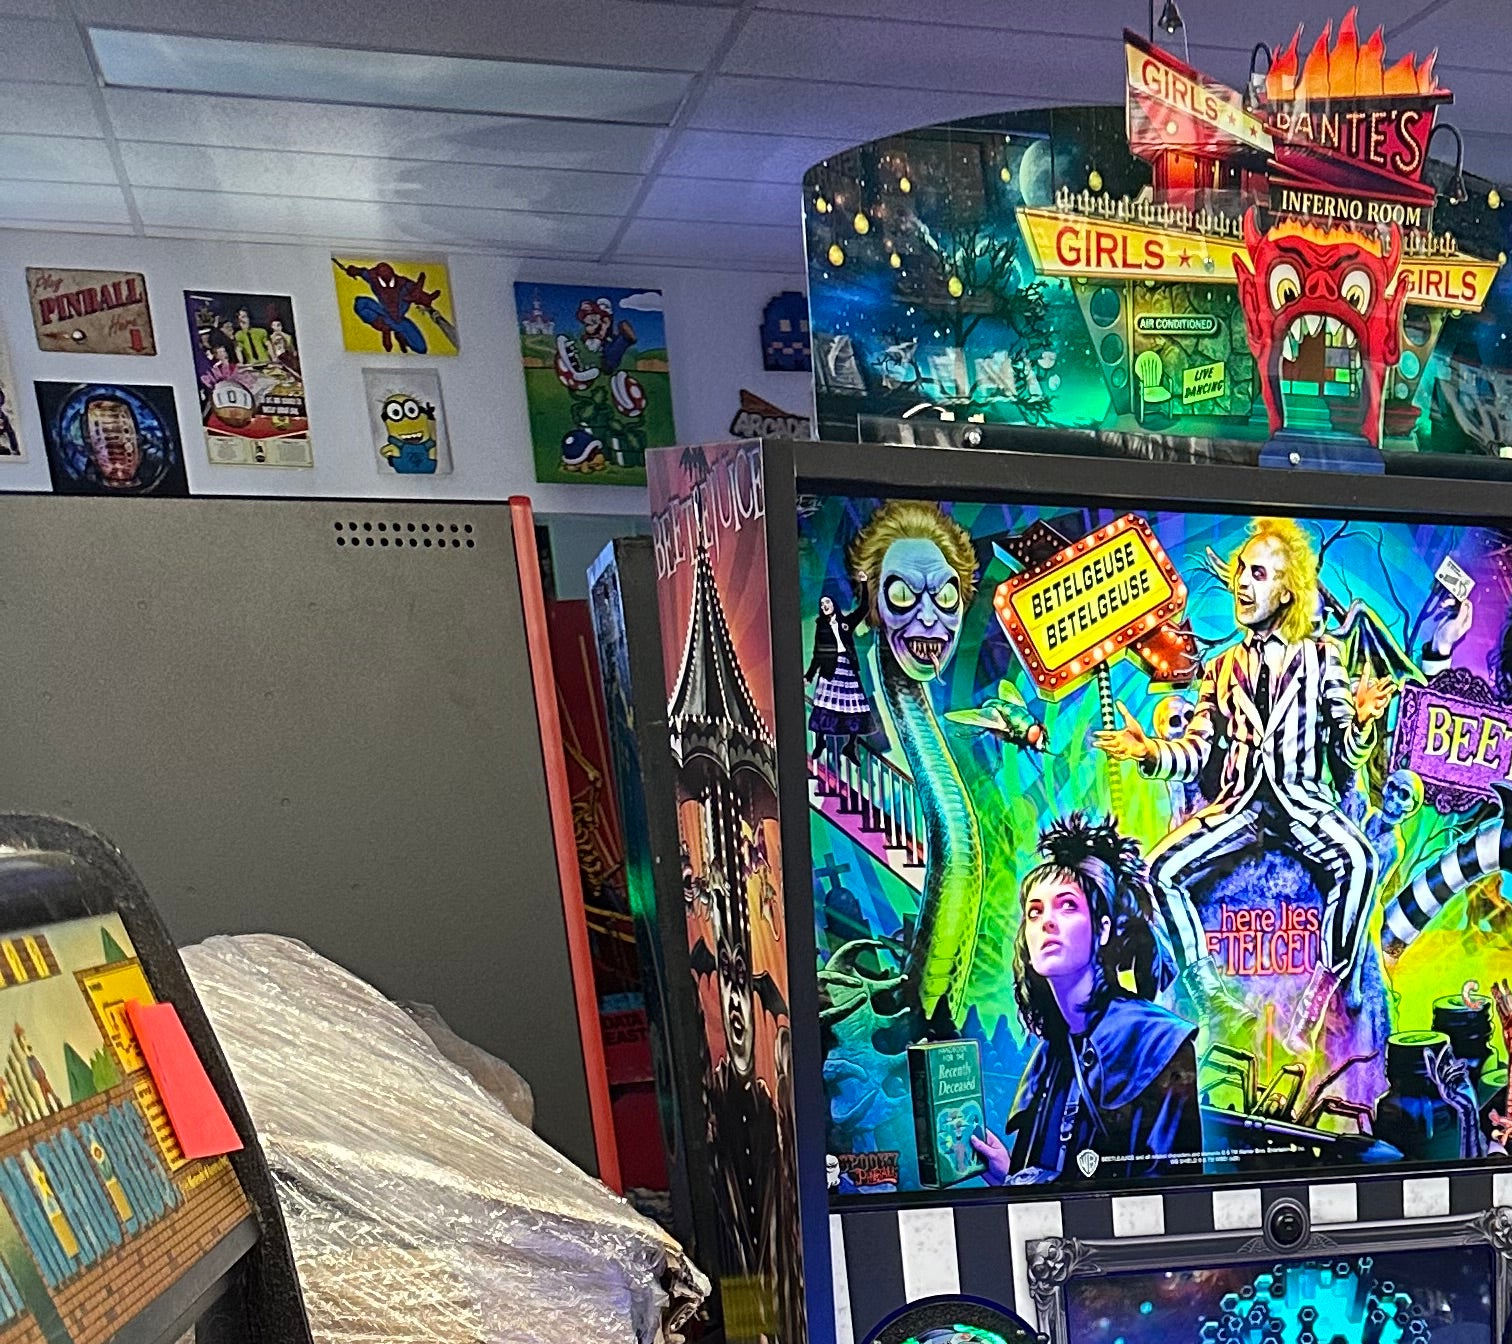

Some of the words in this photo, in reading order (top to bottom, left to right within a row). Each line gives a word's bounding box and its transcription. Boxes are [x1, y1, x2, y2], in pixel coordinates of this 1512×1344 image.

[1141, 58, 1219, 121] GIRLS
[1276, 109, 1423, 175] DANTE'S
[1281, 189, 1364, 221] INFERNO
[1367, 201, 1423, 227] ROOM
[1056, 225, 1166, 270] GIRLS
[39, 278, 143, 325] PINBALL
[1402, 270, 1478, 302] GIRLS
[1155, 318, 1214, 331] CONDITIONED
[1194, 366, 1215, 381] LIVE
[732, 411, 811, 438] ARCADE
[1031, 541, 1135, 620] BETELGEUSE
[1046, 569, 1151, 651] BETELGEUSE
[1222, 902, 1275, 932] here
[1281, 901, 1319, 931] lies
[938, 1062, 972, 1080] Recently
[938, 1078, 976, 1097] Deceased
